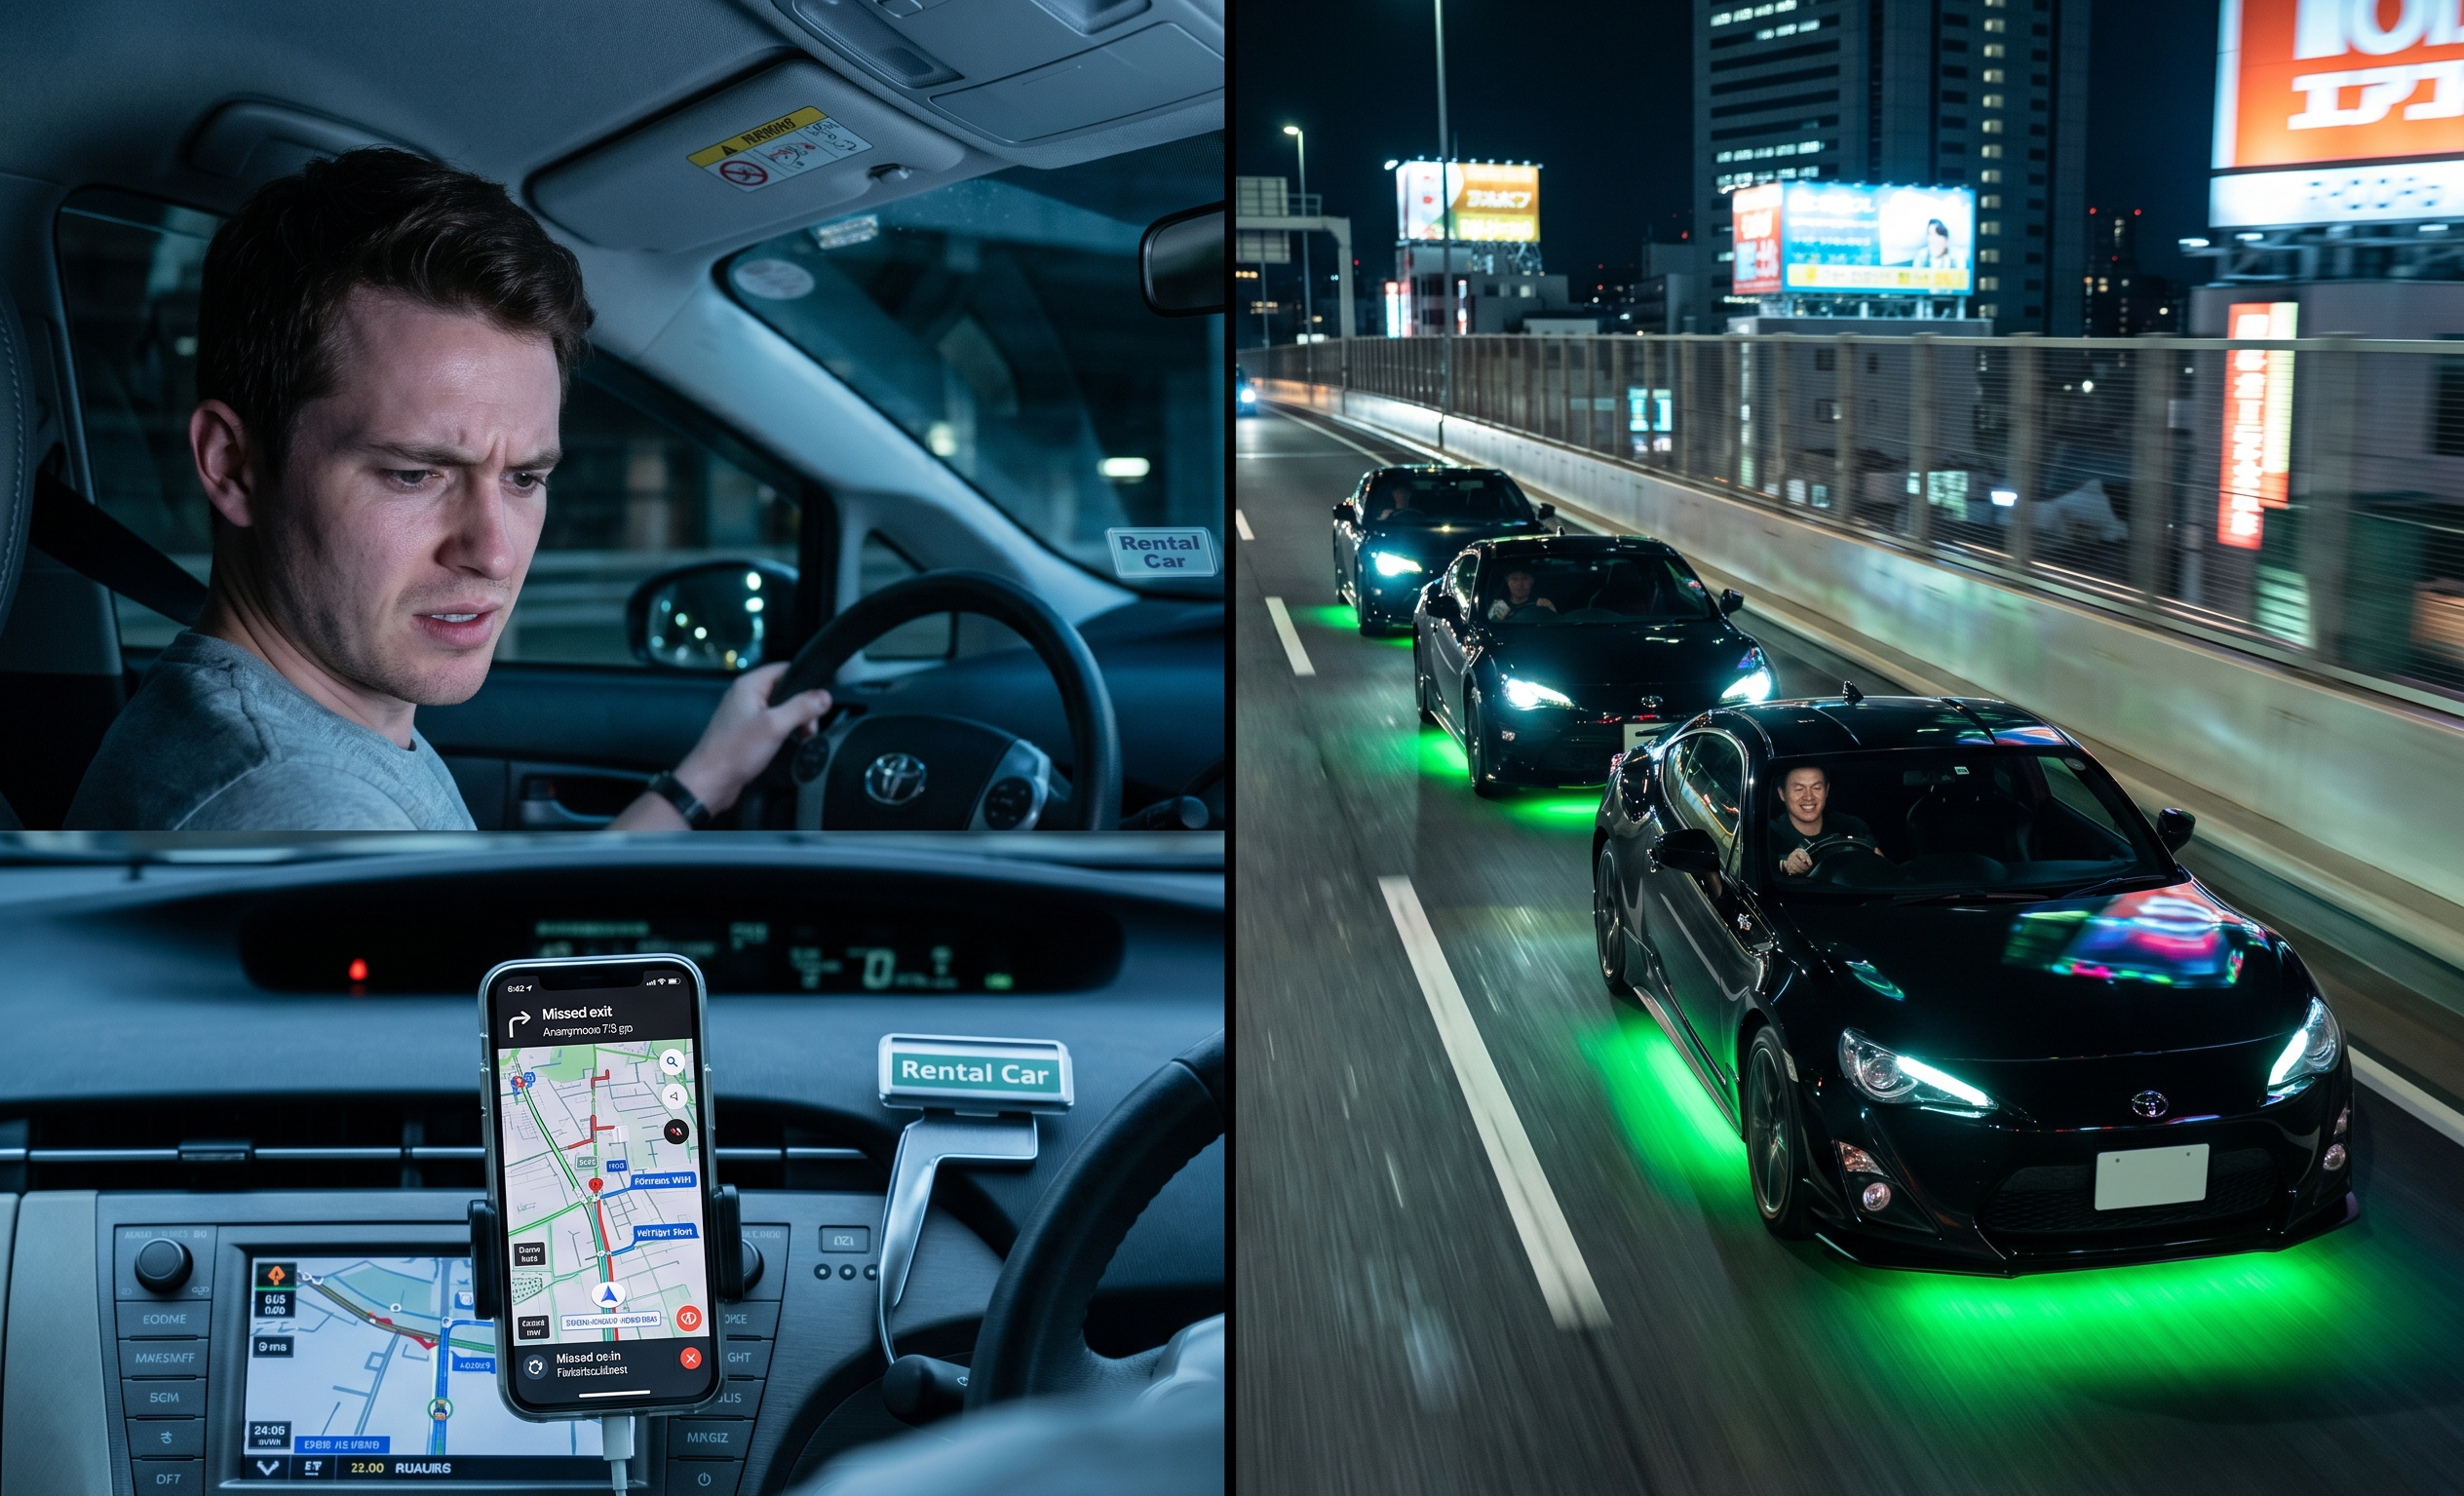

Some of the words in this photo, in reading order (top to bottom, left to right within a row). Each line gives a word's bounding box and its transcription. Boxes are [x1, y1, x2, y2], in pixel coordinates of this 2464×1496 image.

[1119, 535, 1201, 551] Rental
[1143, 553, 1186, 569] Car
[542, 1006, 587, 1020] Missed
[589, 1005, 613, 1017] exit
[902, 1059, 992, 1083] Rental
[1001, 1064, 1050, 1086] Car
